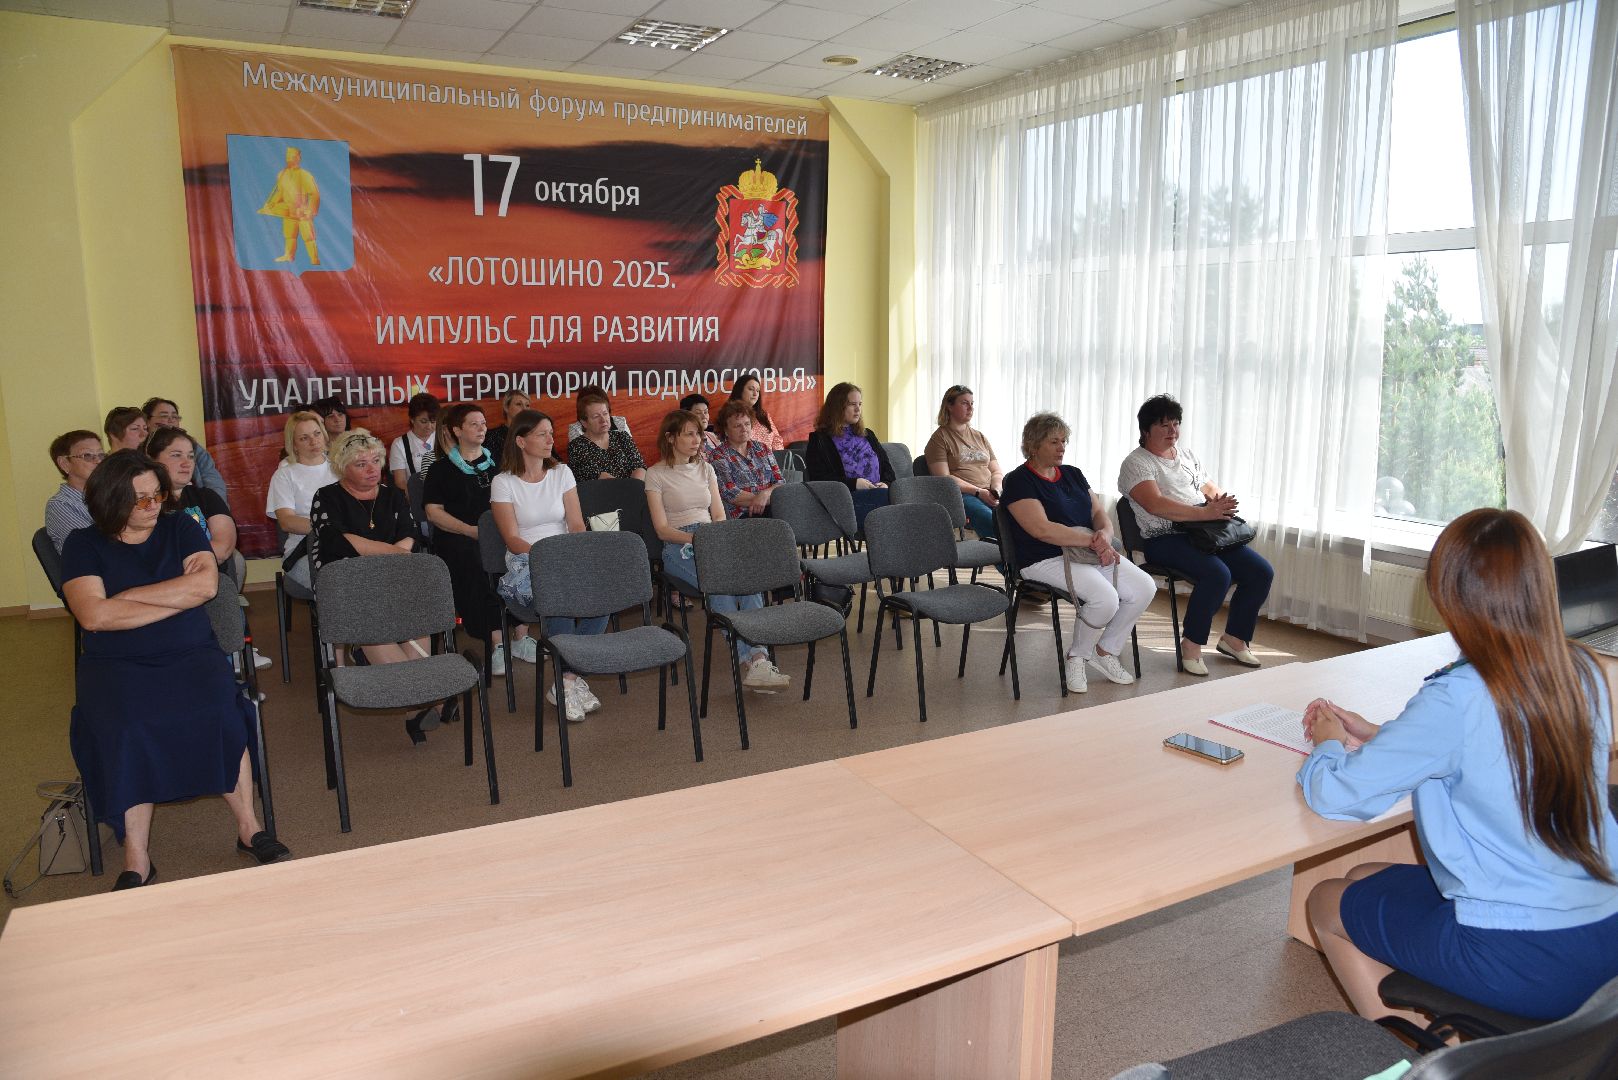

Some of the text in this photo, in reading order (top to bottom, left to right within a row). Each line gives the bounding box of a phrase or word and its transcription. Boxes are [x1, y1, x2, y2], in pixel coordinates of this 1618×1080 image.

[241, 60, 808, 137] Межмуниципальный форум предпринимателей
[463, 153, 641, 217] 17 октября
[428, 255, 677, 290] «ЛОТОШИНО 2025.
[376, 315, 720, 349] ИМПУЛЬС ДЛЯ РАЗВИТИЯ
[238, 374, 431, 414] УДАЛЕННЫХ
[440, 365, 618, 401] ТЕРРИТОРИЙ
